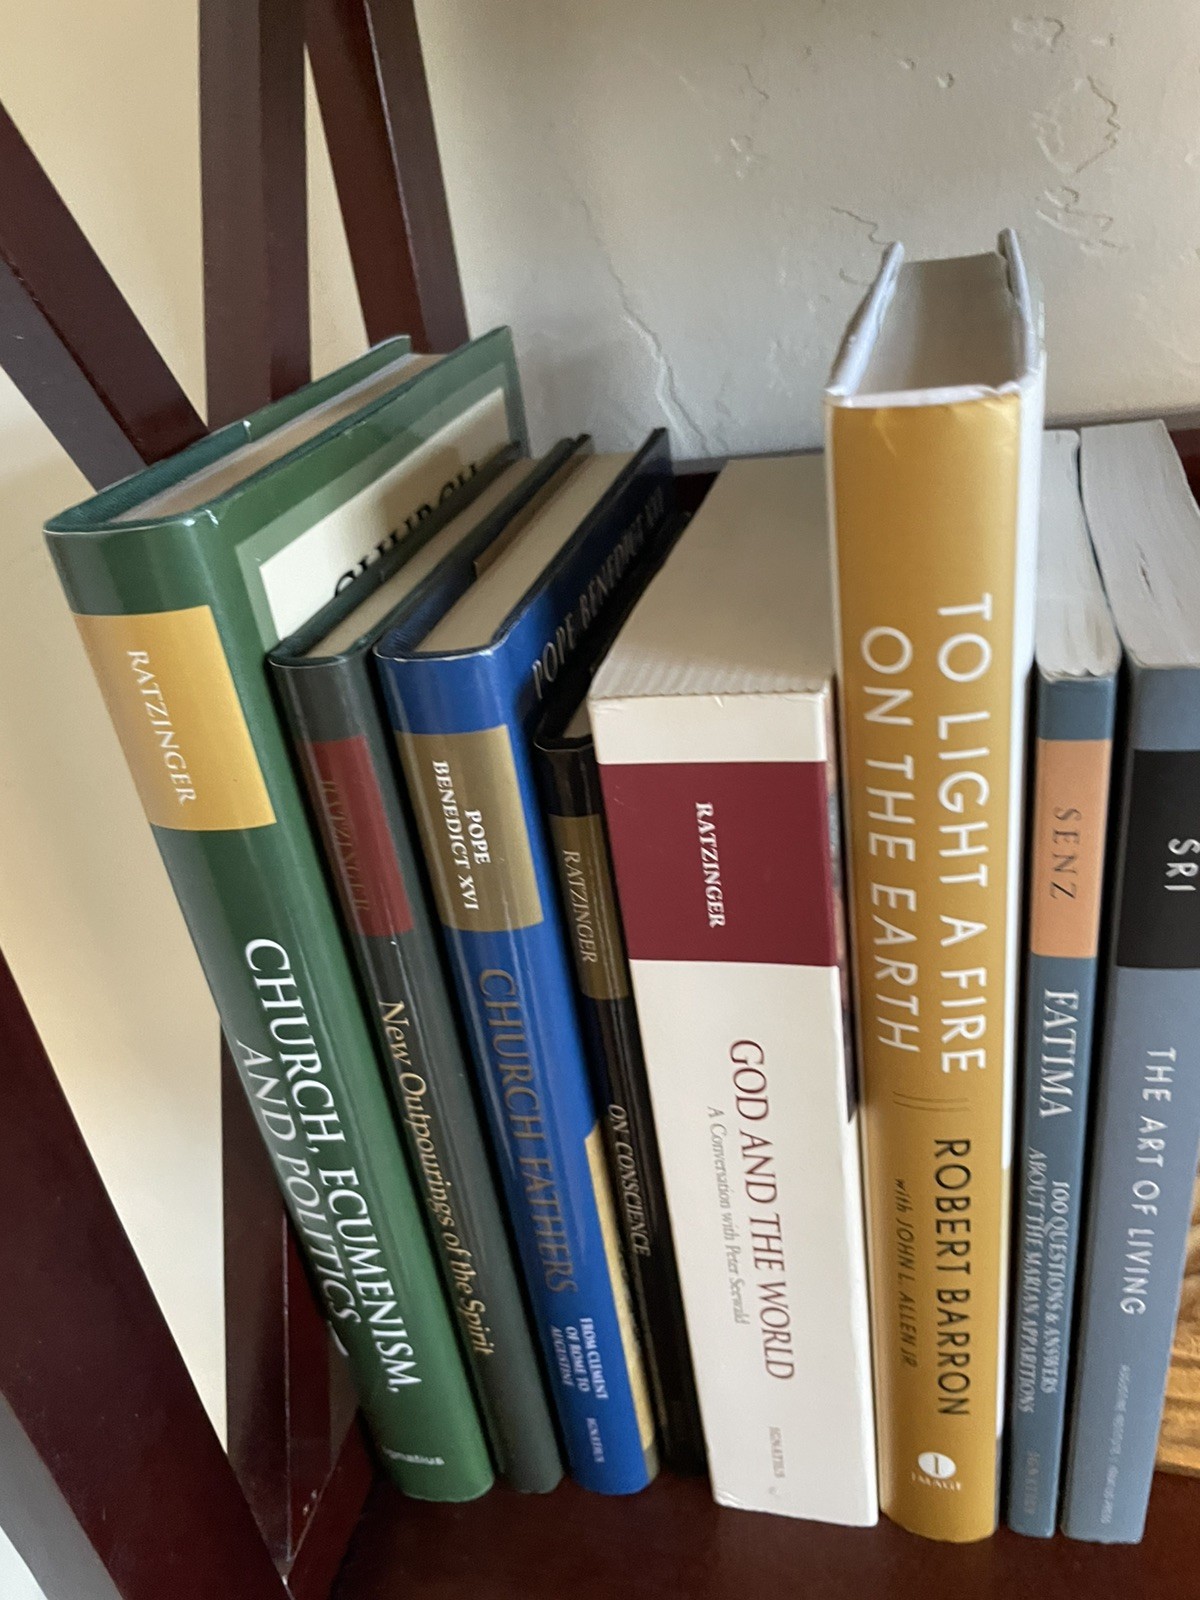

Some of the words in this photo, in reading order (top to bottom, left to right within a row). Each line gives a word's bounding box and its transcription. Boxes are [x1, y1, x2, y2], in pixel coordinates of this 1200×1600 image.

[861, 626, 914, 726] ON
[937, 592, 993, 682] TO
[127, 650, 197, 807] RATZINGER
[432, 759, 472, 870] BENEDICT
[457, 875, 480, 911] XVI
[464, 808, 492, 865] POPE
[865, 754, 917, 862] THE
[938, 711, 991, 887] LIGHT
[695, 801, 726, 929] RATZINGER
[1050, 805, 1082, 900] SENZ
[562, 849, 598, 963] RATZINGER
[939, 915, 988, 947] A
[870, 881, 921, 1053] EARTH
[378, 999, 413, 1067] New
[940, 967, 988, 1074] FIRE
[1038, 988, 1080, 1119] FATIMA
[707, 1105, 726, 1118] A
[729, 1039, 770, 1121] GOD
[1142, 1047, 1177, 1102] THE
[398, 1071, 455, 1228] Outpourings
[478, 968, 545, 1141] CHURCH
[519, 1155, 578, 1295] FATHERS
[608, 1103, 631, 1134] ON
[1135, 1115, 1168, 1168] ART
[236, 1039, 297, 1142] AND
[276, 1152, 362, 1324] POLITICS
[244, 938, 347, 1153] CHURCH,
[318, 1166, 423, 1394] ECUMENISM,
[614, 1140, 651, 1257] CONSCIENCE
[709, 1123, 735, 1209] Conversation
[738, 1128, 779, 1204] AND
[895, 1177, 914, 1214] with
[934, 1138, 972, 1276] ROBERT
[1027, 1146, 1048, 1212] ABOUT
[1050, 1180, 1071, 1214] 100
[1131, 1180, 1161, 1216] OF
[442, 1231, 473, 1257] of
[722, 1212, 740, 1242] with
[725, 1244, 742, 1275] Peter
[748, 1212, 785, 1273] THE
[896, 1216, 916, 1271] JOHN
[1025, 1213, 1045, 1249] THE
[1043, 1216, 1070, 1312] QUESTIONS
[450, 1260, 478, 1295] the
[1119, 1227, 1155, 1315] LIVING
[458, 1298, 496, 1356] Spirit
[579, 1317, 598, 1349] FROM
[756, 1281, 795, 1380] WORLD
[898, 1290, 918, 1347] ALLEN
[936, 1288, 971, 1416] BARRON
[586, 1350, 610, 1399] CLEMENT
